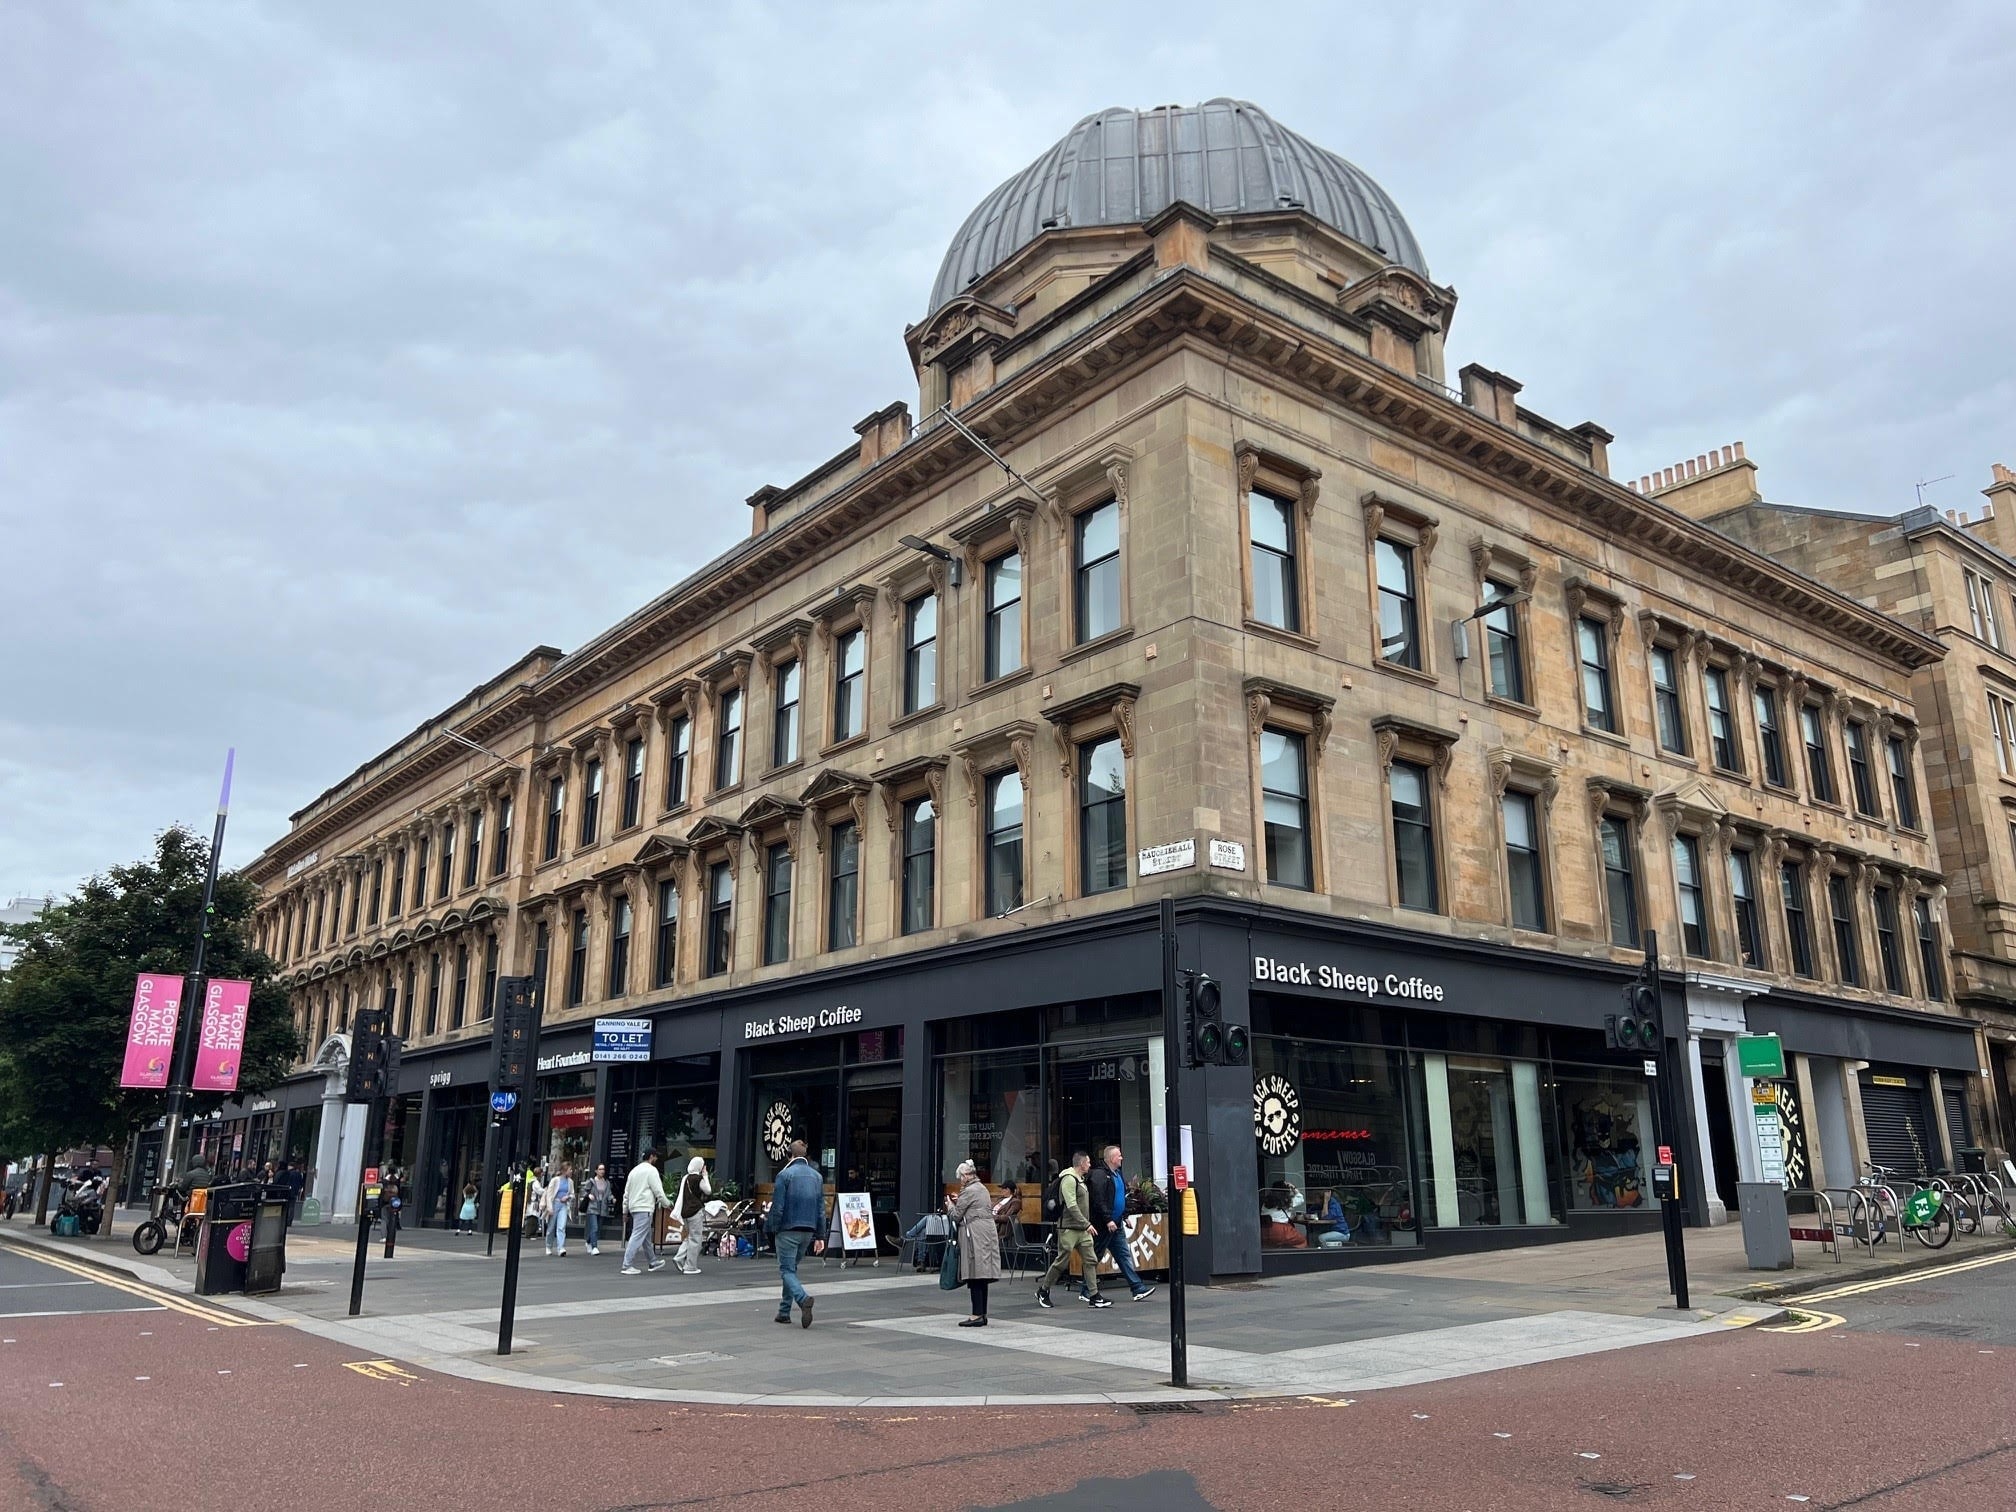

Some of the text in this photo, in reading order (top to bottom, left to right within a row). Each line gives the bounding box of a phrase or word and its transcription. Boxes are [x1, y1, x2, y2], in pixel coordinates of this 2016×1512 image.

[1217, 844, 1236, 855] ROSE
[1255, 957, 1444, 1001] Black Sheep Coffee
[132, 980, 153, 1045] GLASGOW
[145, 1009, 162, 1046] MAKE
[158, 1000, 177, 1047] PEOPLE
[203, 985, 222, 1049] GLASGOW
[228, 1005, 245, 1051] PEOPLE
[745, 1006, 862, 1039] Black Sheep Coffee
[215, 1014, 231, 1050] MAKE
[602, 1033, 644, 1043] TO LET
[430, 1070, 451, 1087] sprigg
[537, 1051, 591, 1071] Heart Foundation
[1253, 1075, 1299, 1121] BLACK SHEEP
[764, 1101, 792, 1141] BLACK SHEEP
[1262, 1123, 1299, 1155] COFFEE
[1301, 1130, 1371, 1140] onsense
[771, 1134, 792, 1161] COFFEE
